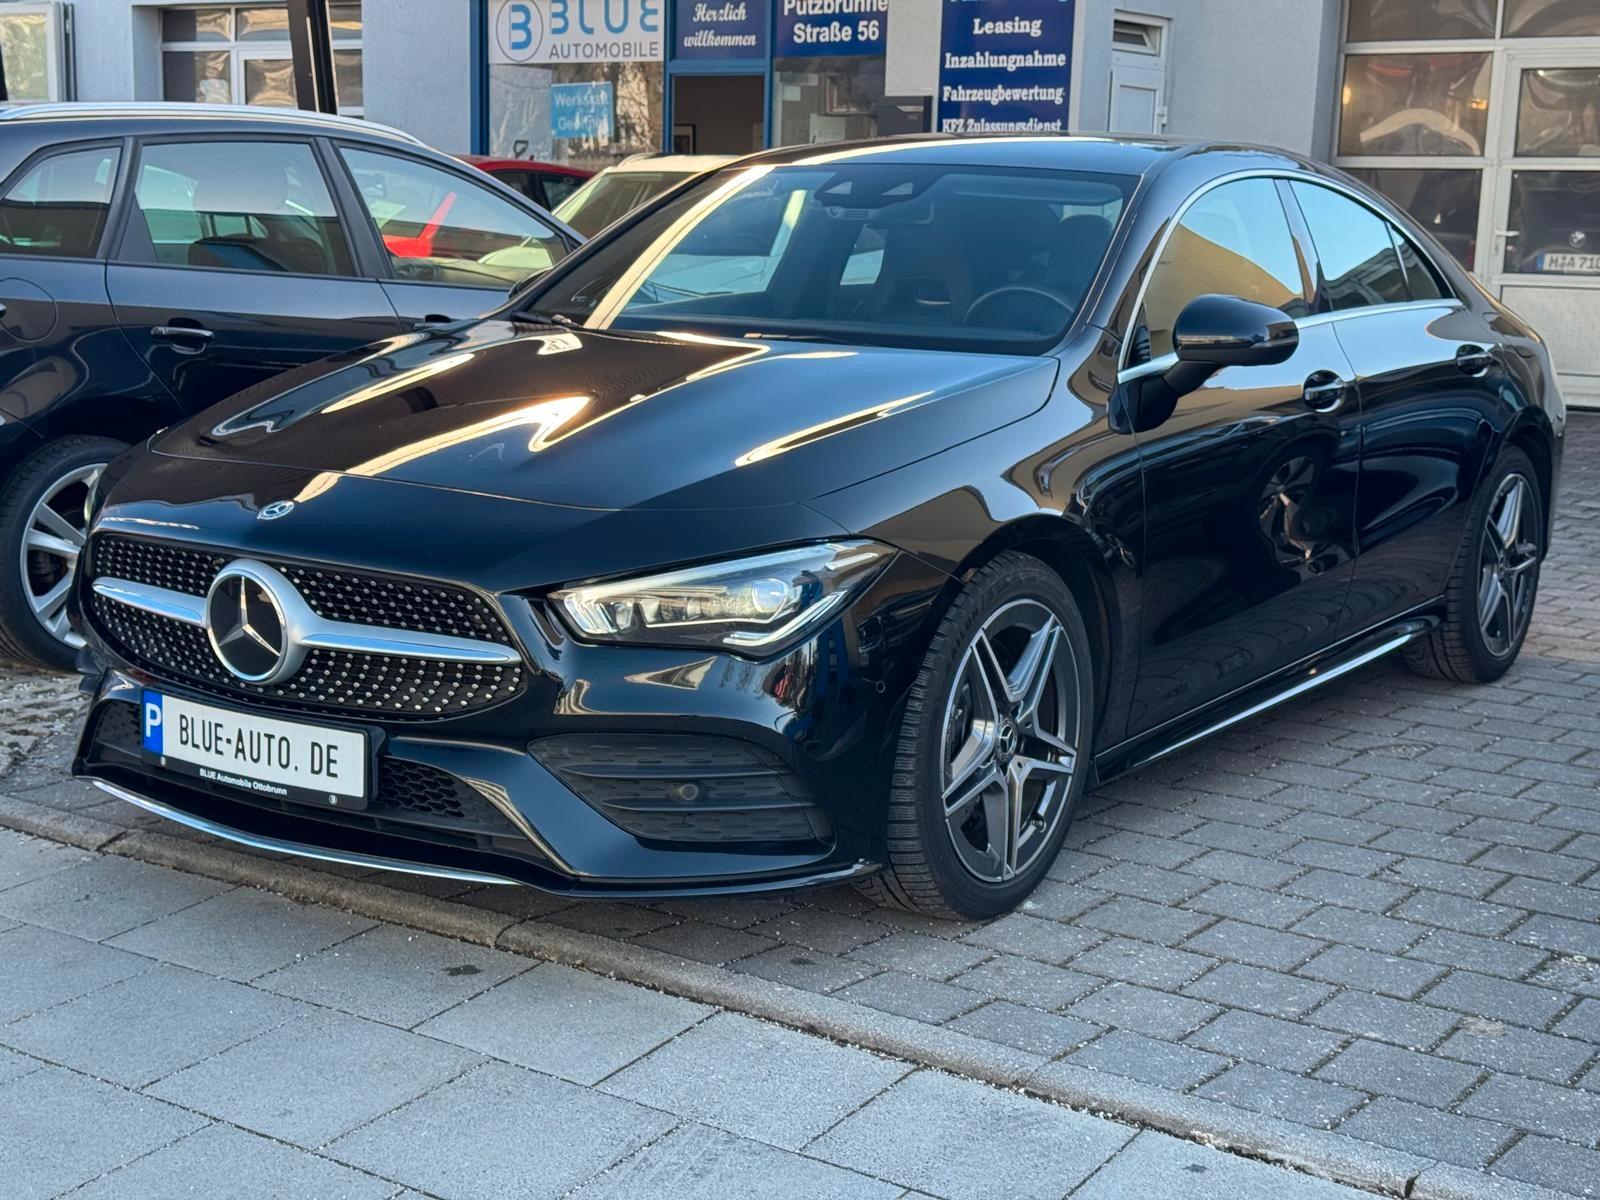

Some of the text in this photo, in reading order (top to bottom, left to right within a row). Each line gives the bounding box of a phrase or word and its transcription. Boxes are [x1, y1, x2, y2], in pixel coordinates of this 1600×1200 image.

[551, 0, 659, 35] BLUE
[693, 2, 748, 23] Herzlich
[793, 19, 880, 44] Straße 56
[972, 16, 1043, 37] Leasing
[684, 30, 758, 48] willkommen
[549, 41, 659, 59] AUTOMOBILE
[944, 50, 1066, 72] Inzahlungnahme
[942, 85, 1064, 105] Fahrzeugbewertung
[942, 118, 965, 133] KFZ
[145, 702, 162, 738] P
[199, 767, 288, 796] BLUE Automobile Ottobrunn
